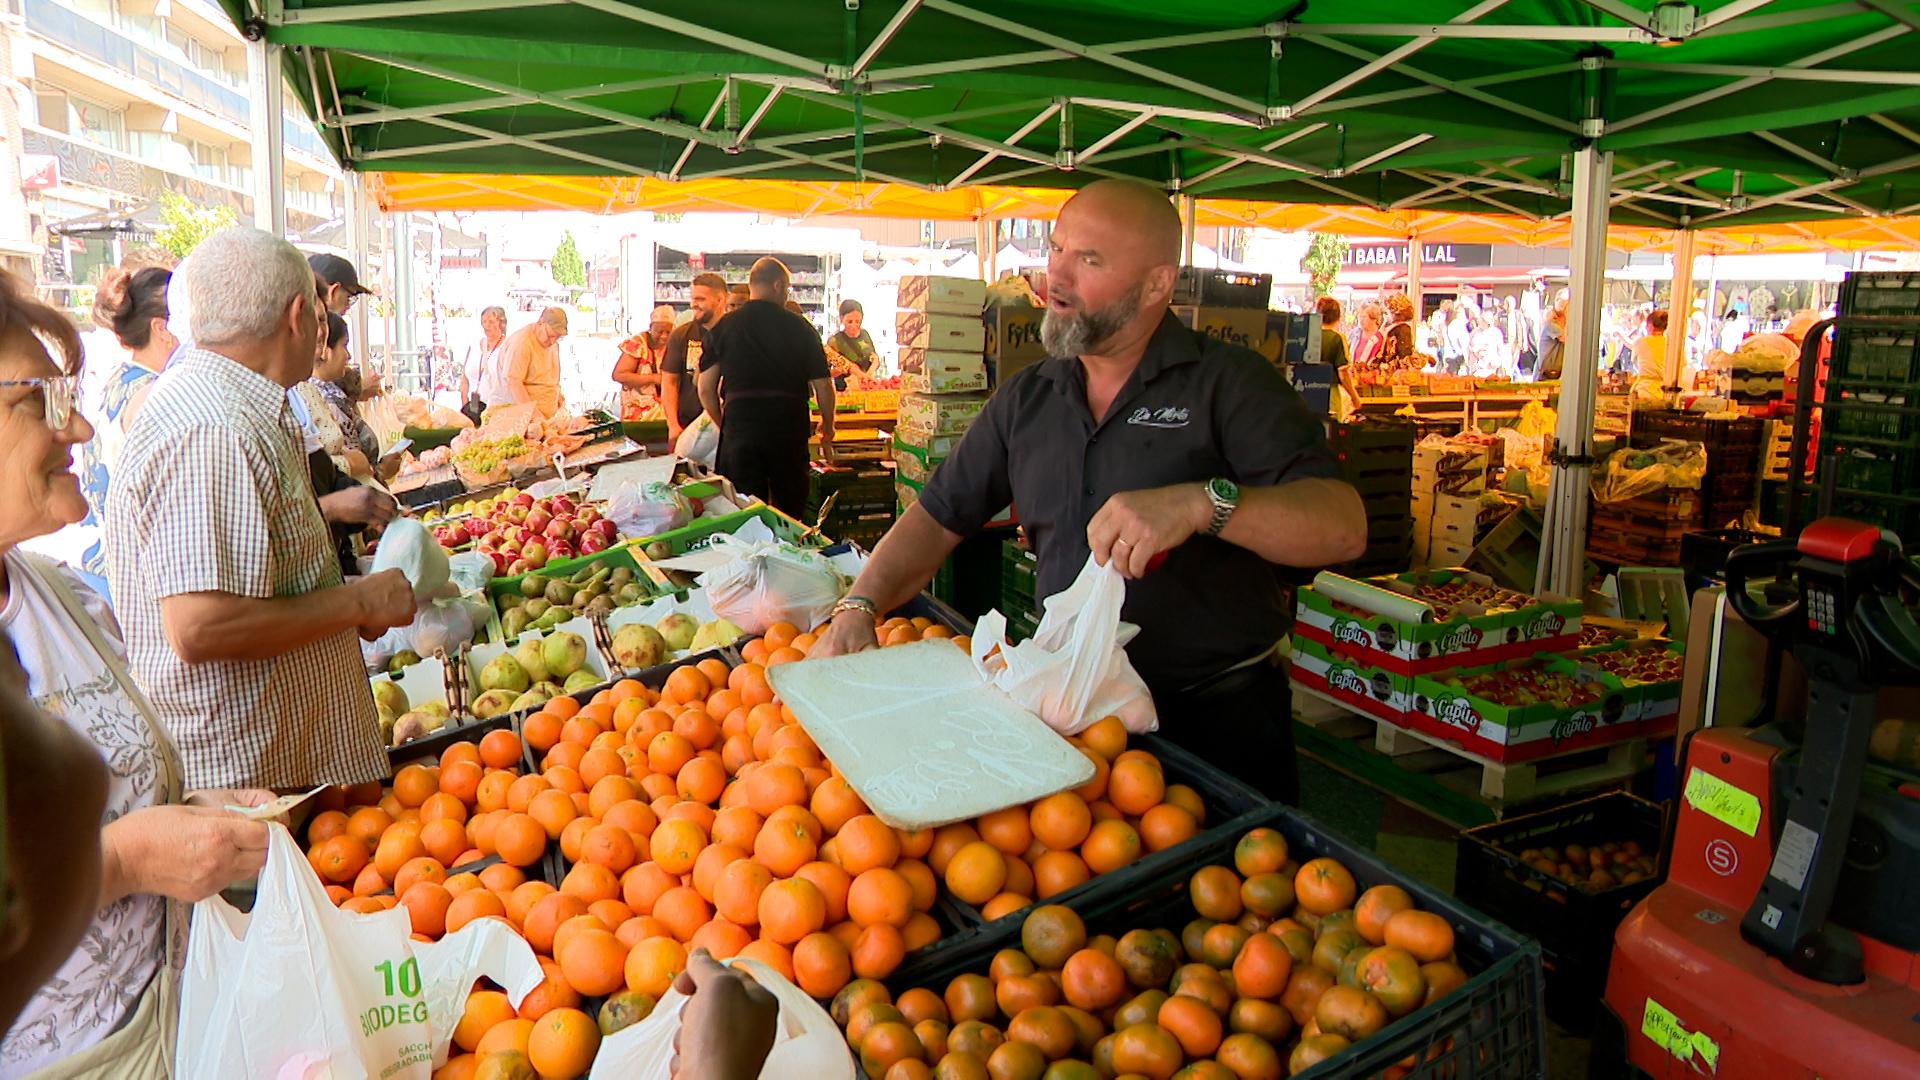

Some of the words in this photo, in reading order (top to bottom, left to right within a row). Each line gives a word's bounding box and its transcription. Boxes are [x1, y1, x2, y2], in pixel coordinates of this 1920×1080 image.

[1355, 246, 1397, 265] BABA
[374, 956, 421, 998] 10
[360, 1001, 428, 1038] BIODEG
